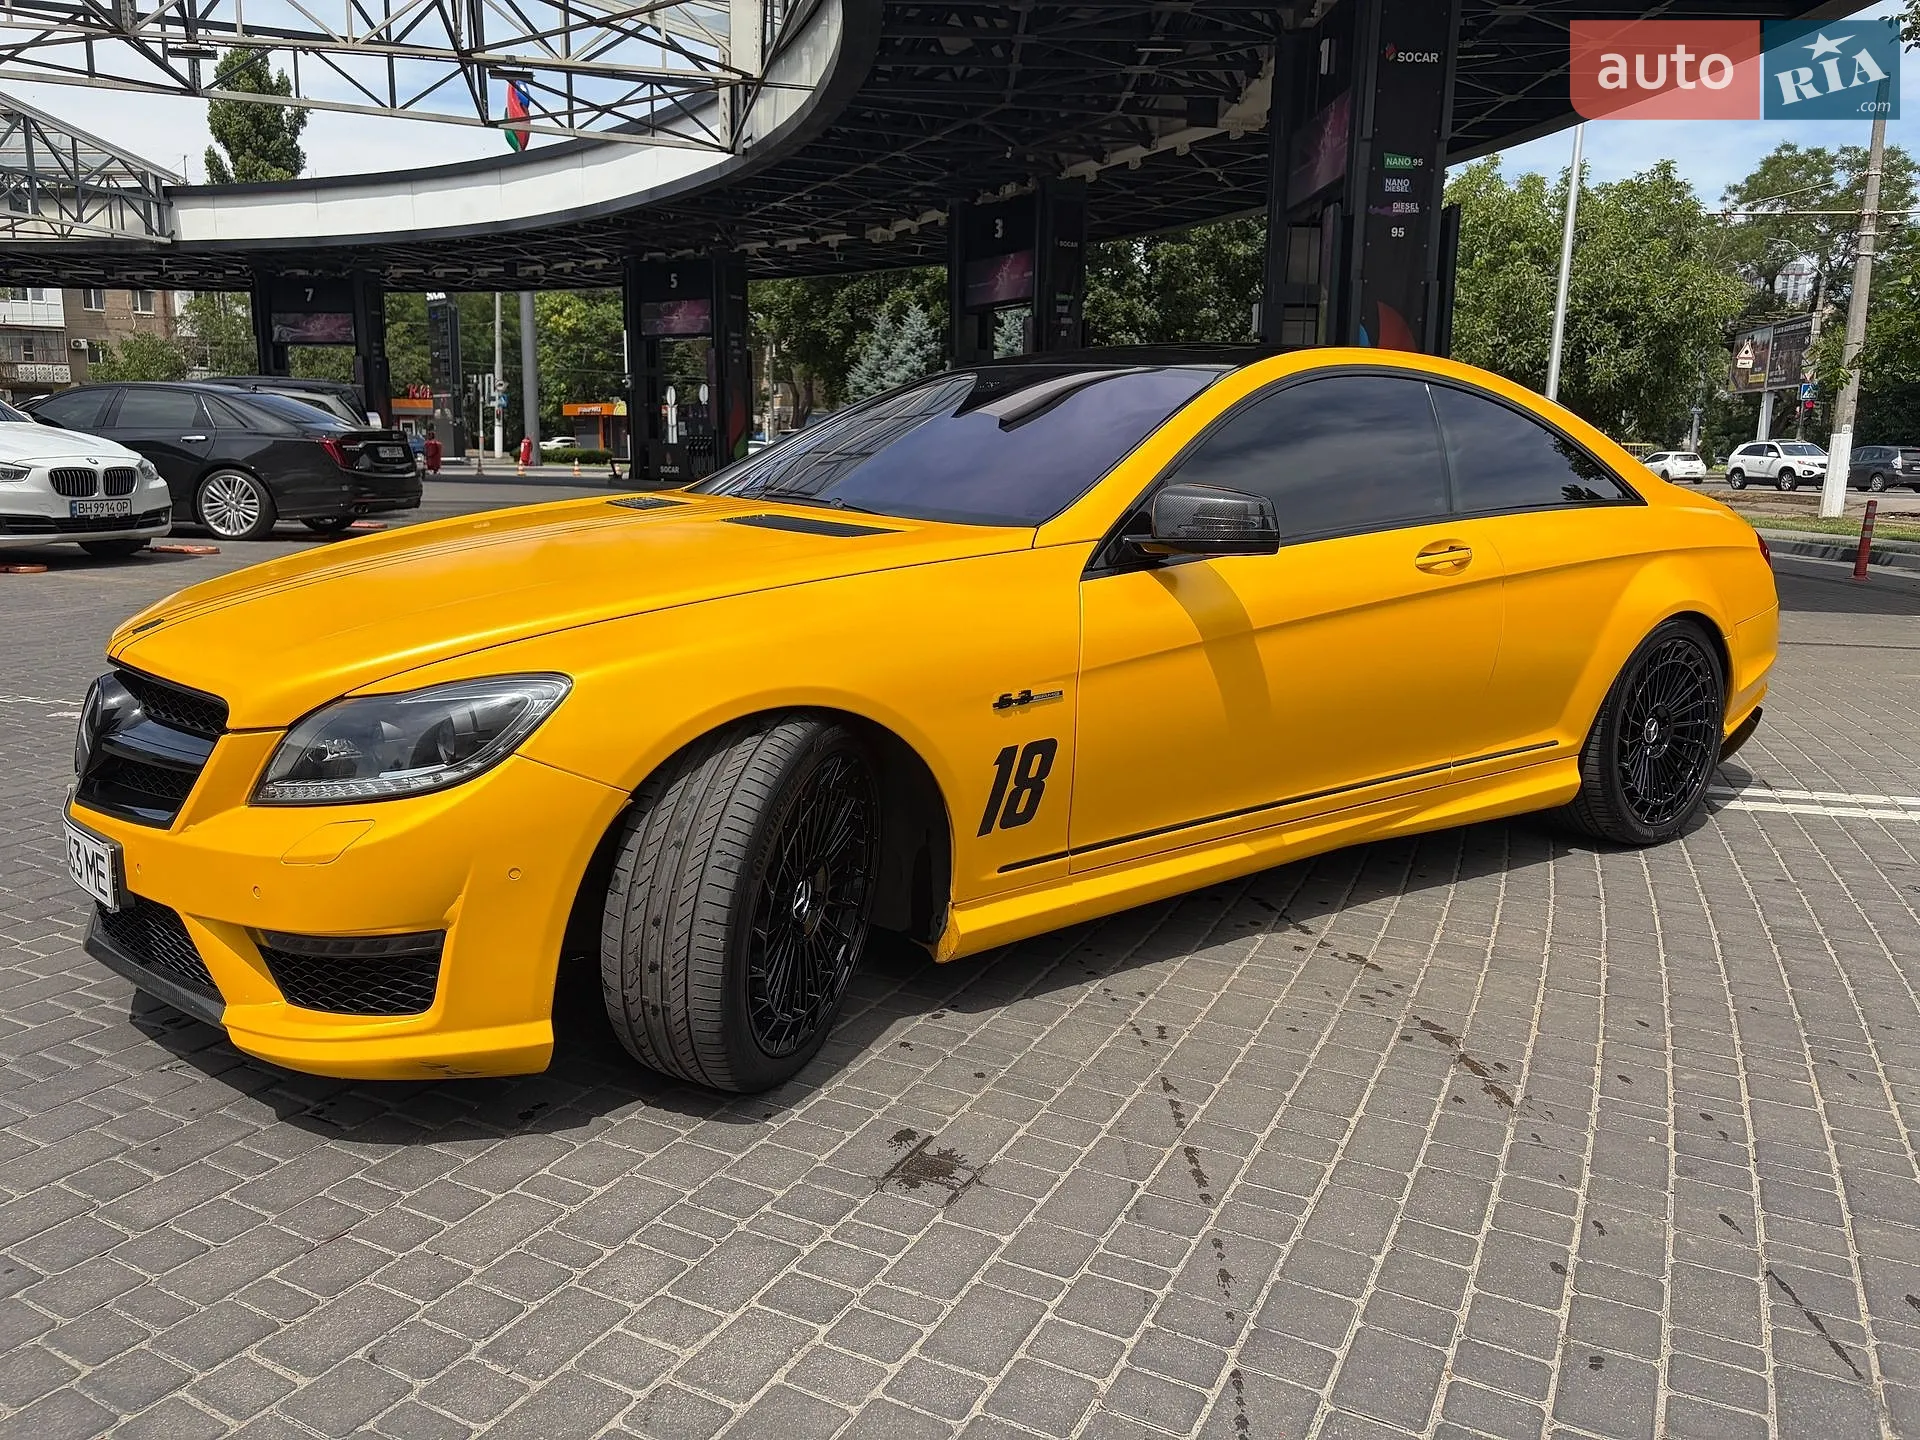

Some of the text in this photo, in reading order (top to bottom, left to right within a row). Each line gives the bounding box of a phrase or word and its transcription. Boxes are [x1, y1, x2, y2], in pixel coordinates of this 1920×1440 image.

[1397, 51, 1439, 63] SOCAR
[1386, 157, 1423, 166] NANO 95
[1385, 178, 1410, 187] NANO
[1385, 185, 1409, 193] DIESEL
[1392, 202, 1420, 210] DIESEL
[994, 218, 1004, 239] 3
[1391, 227, 1405, 238] 95
[670, 273, 678, 289] 5
[305, 287, 314, 302] 7
[660, 465, 680, 473] SOCAR
[976, 737, 1058, 838] 18
